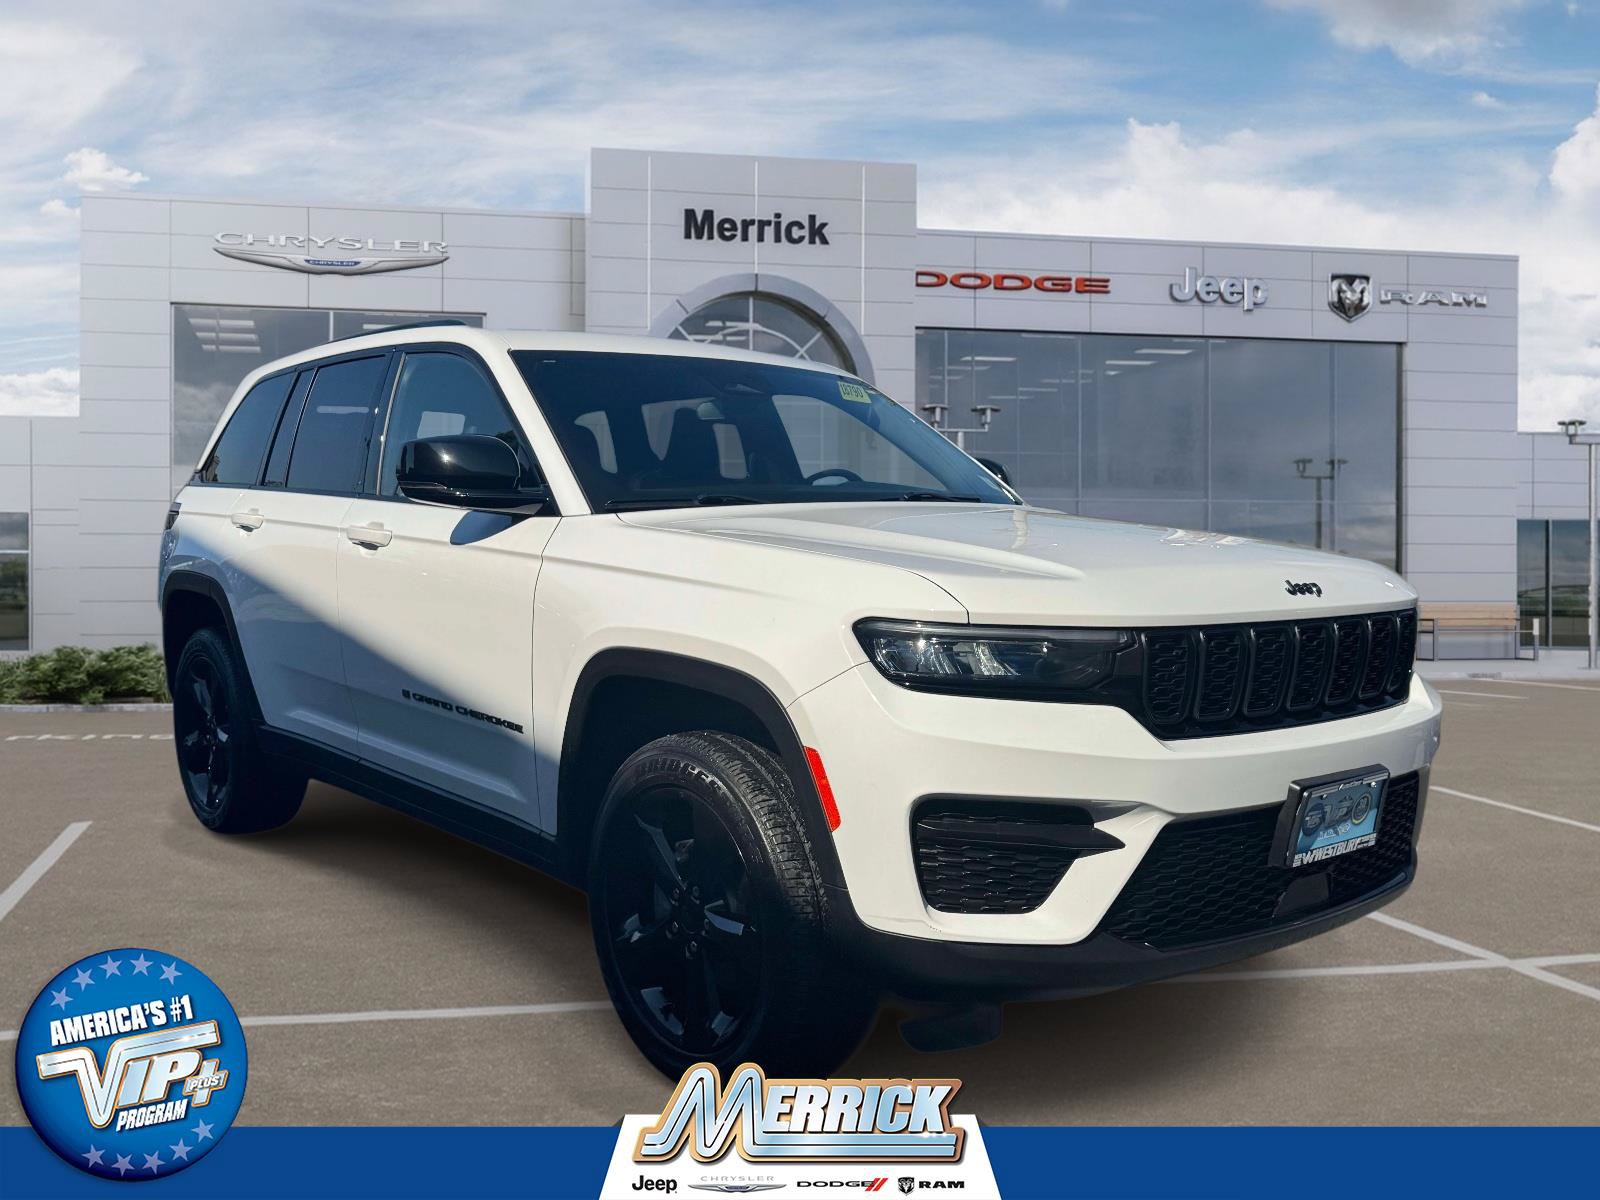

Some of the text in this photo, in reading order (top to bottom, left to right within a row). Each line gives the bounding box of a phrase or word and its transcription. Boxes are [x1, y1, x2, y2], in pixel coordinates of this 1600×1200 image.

[684, 208, 830, 245] Merrick
[213, 231, 448, 254] CHRYSLER
[915, 270, 1111, 294] DODGE
[1169, 266, 1268, 312] Jeep
[1380, 289, 1488, 308] RAM
[1284, 579, 1322, 598] Jeep
[412, 692, 524, 735] GRAND CHEROKEE
